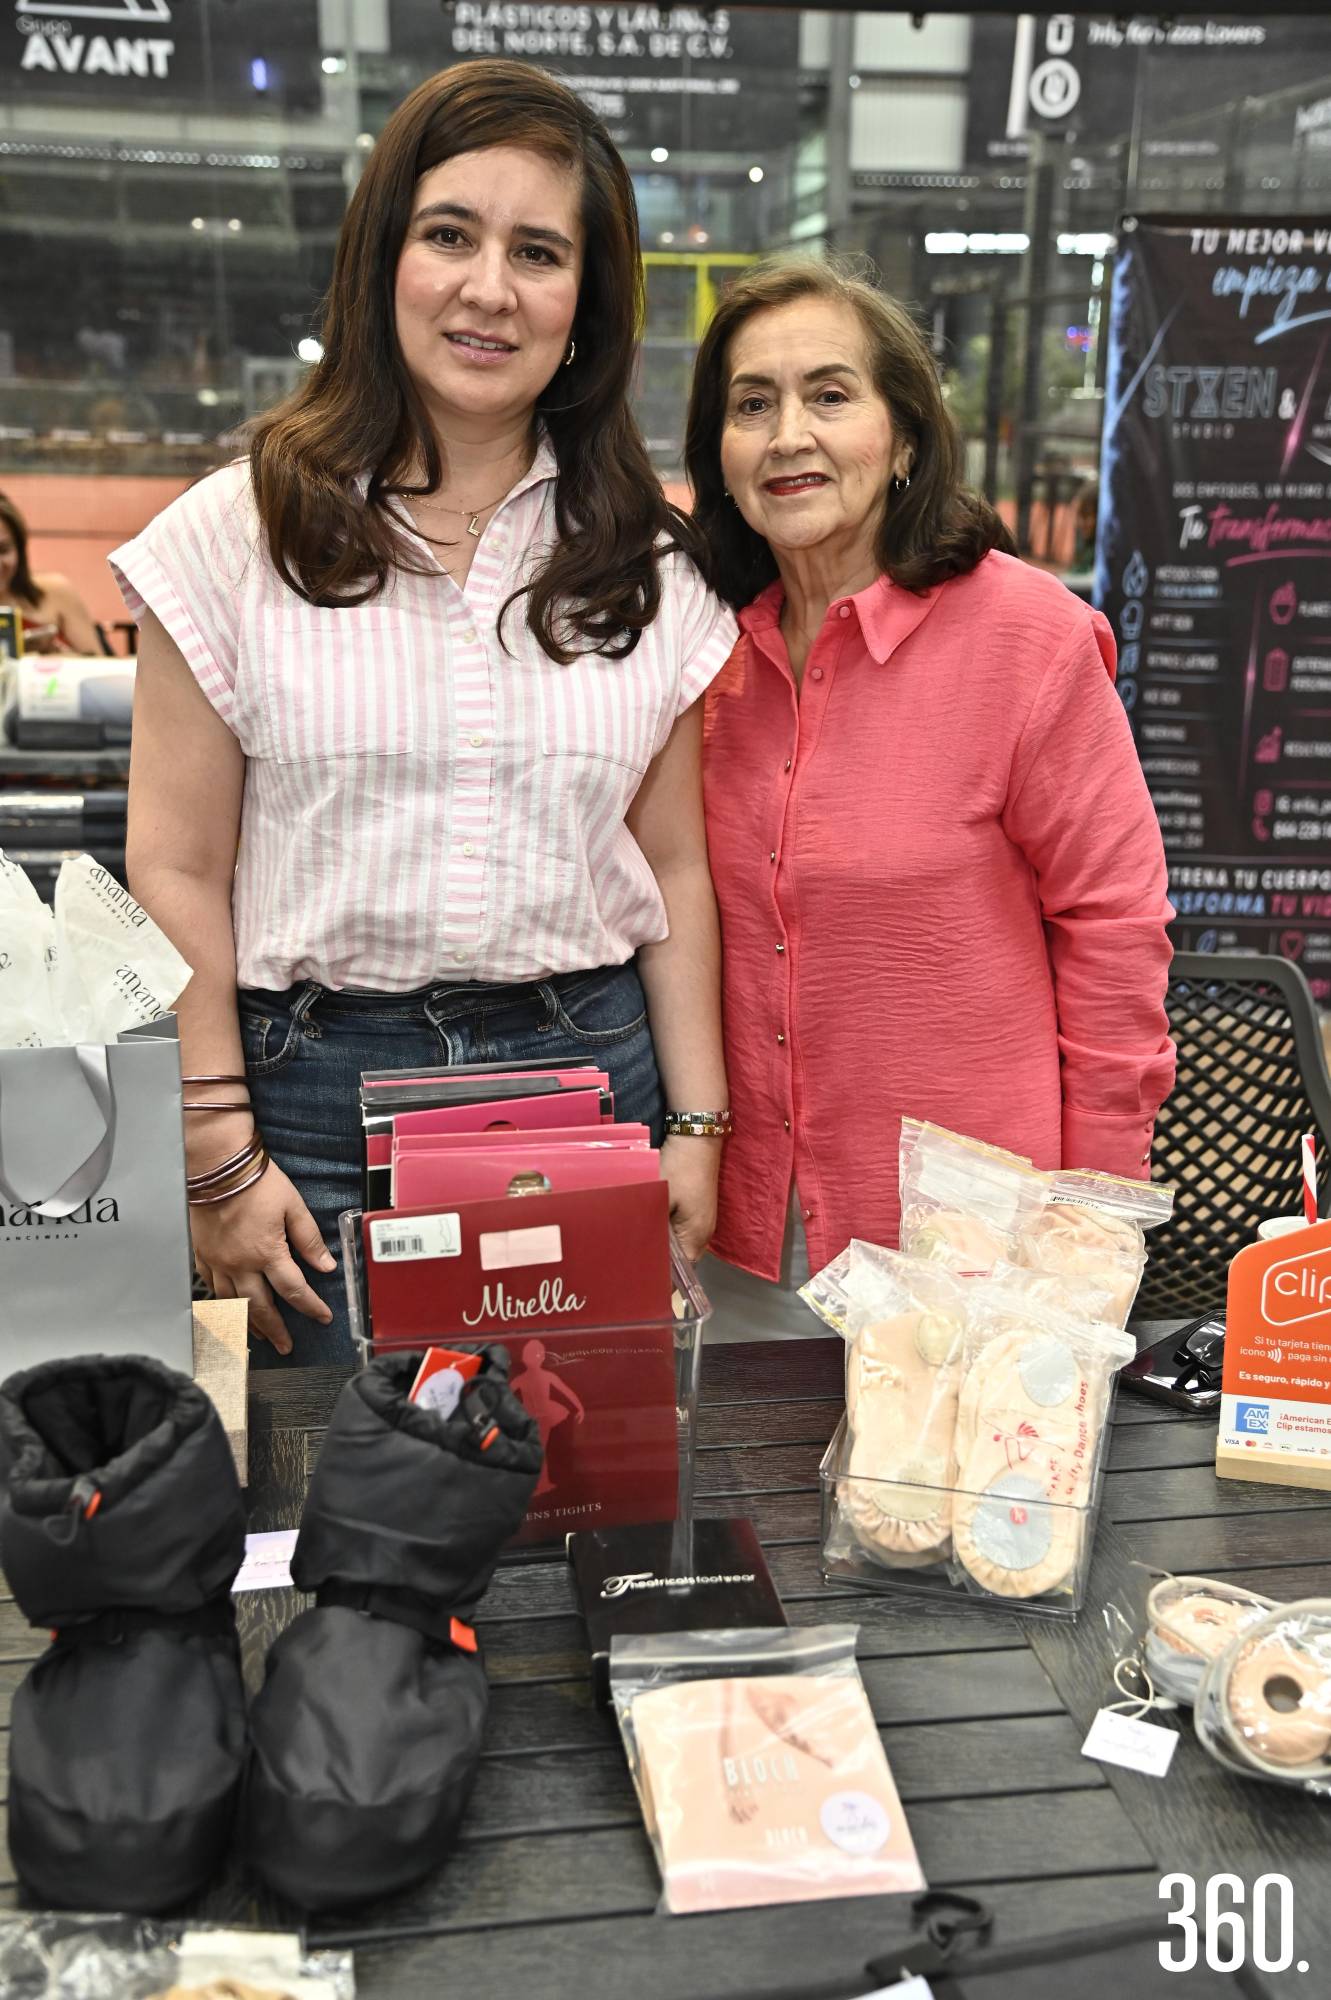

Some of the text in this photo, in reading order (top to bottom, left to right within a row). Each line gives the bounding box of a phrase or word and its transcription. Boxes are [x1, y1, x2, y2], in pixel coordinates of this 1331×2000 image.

[21, 34, 174, 78] AVANT
[452, 27, 499, 53] DEL
[649, 32, 683, 58] DE
[1190, 228, 1221, 255] TU
[1226, 228, 1305, 255] MEJOR
[1211, 256, 1322, 326] empieza
[1278, 388, 1297, 420] &
[1179, 505, 1207, 549] Tu
[1170, 866, 1331, 891] TRENA TU CUERPO
[89, 866, 148, 928] ananda
[1270, 894, 1297, 917] TU
[114, 981, 149, 1023] DANCEW
[0, 1233, 78, 1242] ANCEWEAR
[1274, 1267, 1331, 1304] clip
[463, 1277, 587, 1326] Mirella
[1254, 1335, 1264, 1345] Si
[1266, 1337, 1276, 1346] tu
[1278, 1338, 1310, 1351] tarjeta
[1287, 1352, 1311, 1363] paga
[1312, 1354, 1328, 1363] sin
[1239, 1370, 1330, 1390] Es seguro, rápido y
[1073, 1421, 1087, 1459] Dance
[1276, 1421, 1293, 1431] Clip
[1224, 1437, 1240, 1446] VISA
[526, 1502, 602, 1521] ENS TIGHTS
[696, 1573, 756, 1584] footwear
[722, 1752, 800, 1787] BLOCH
